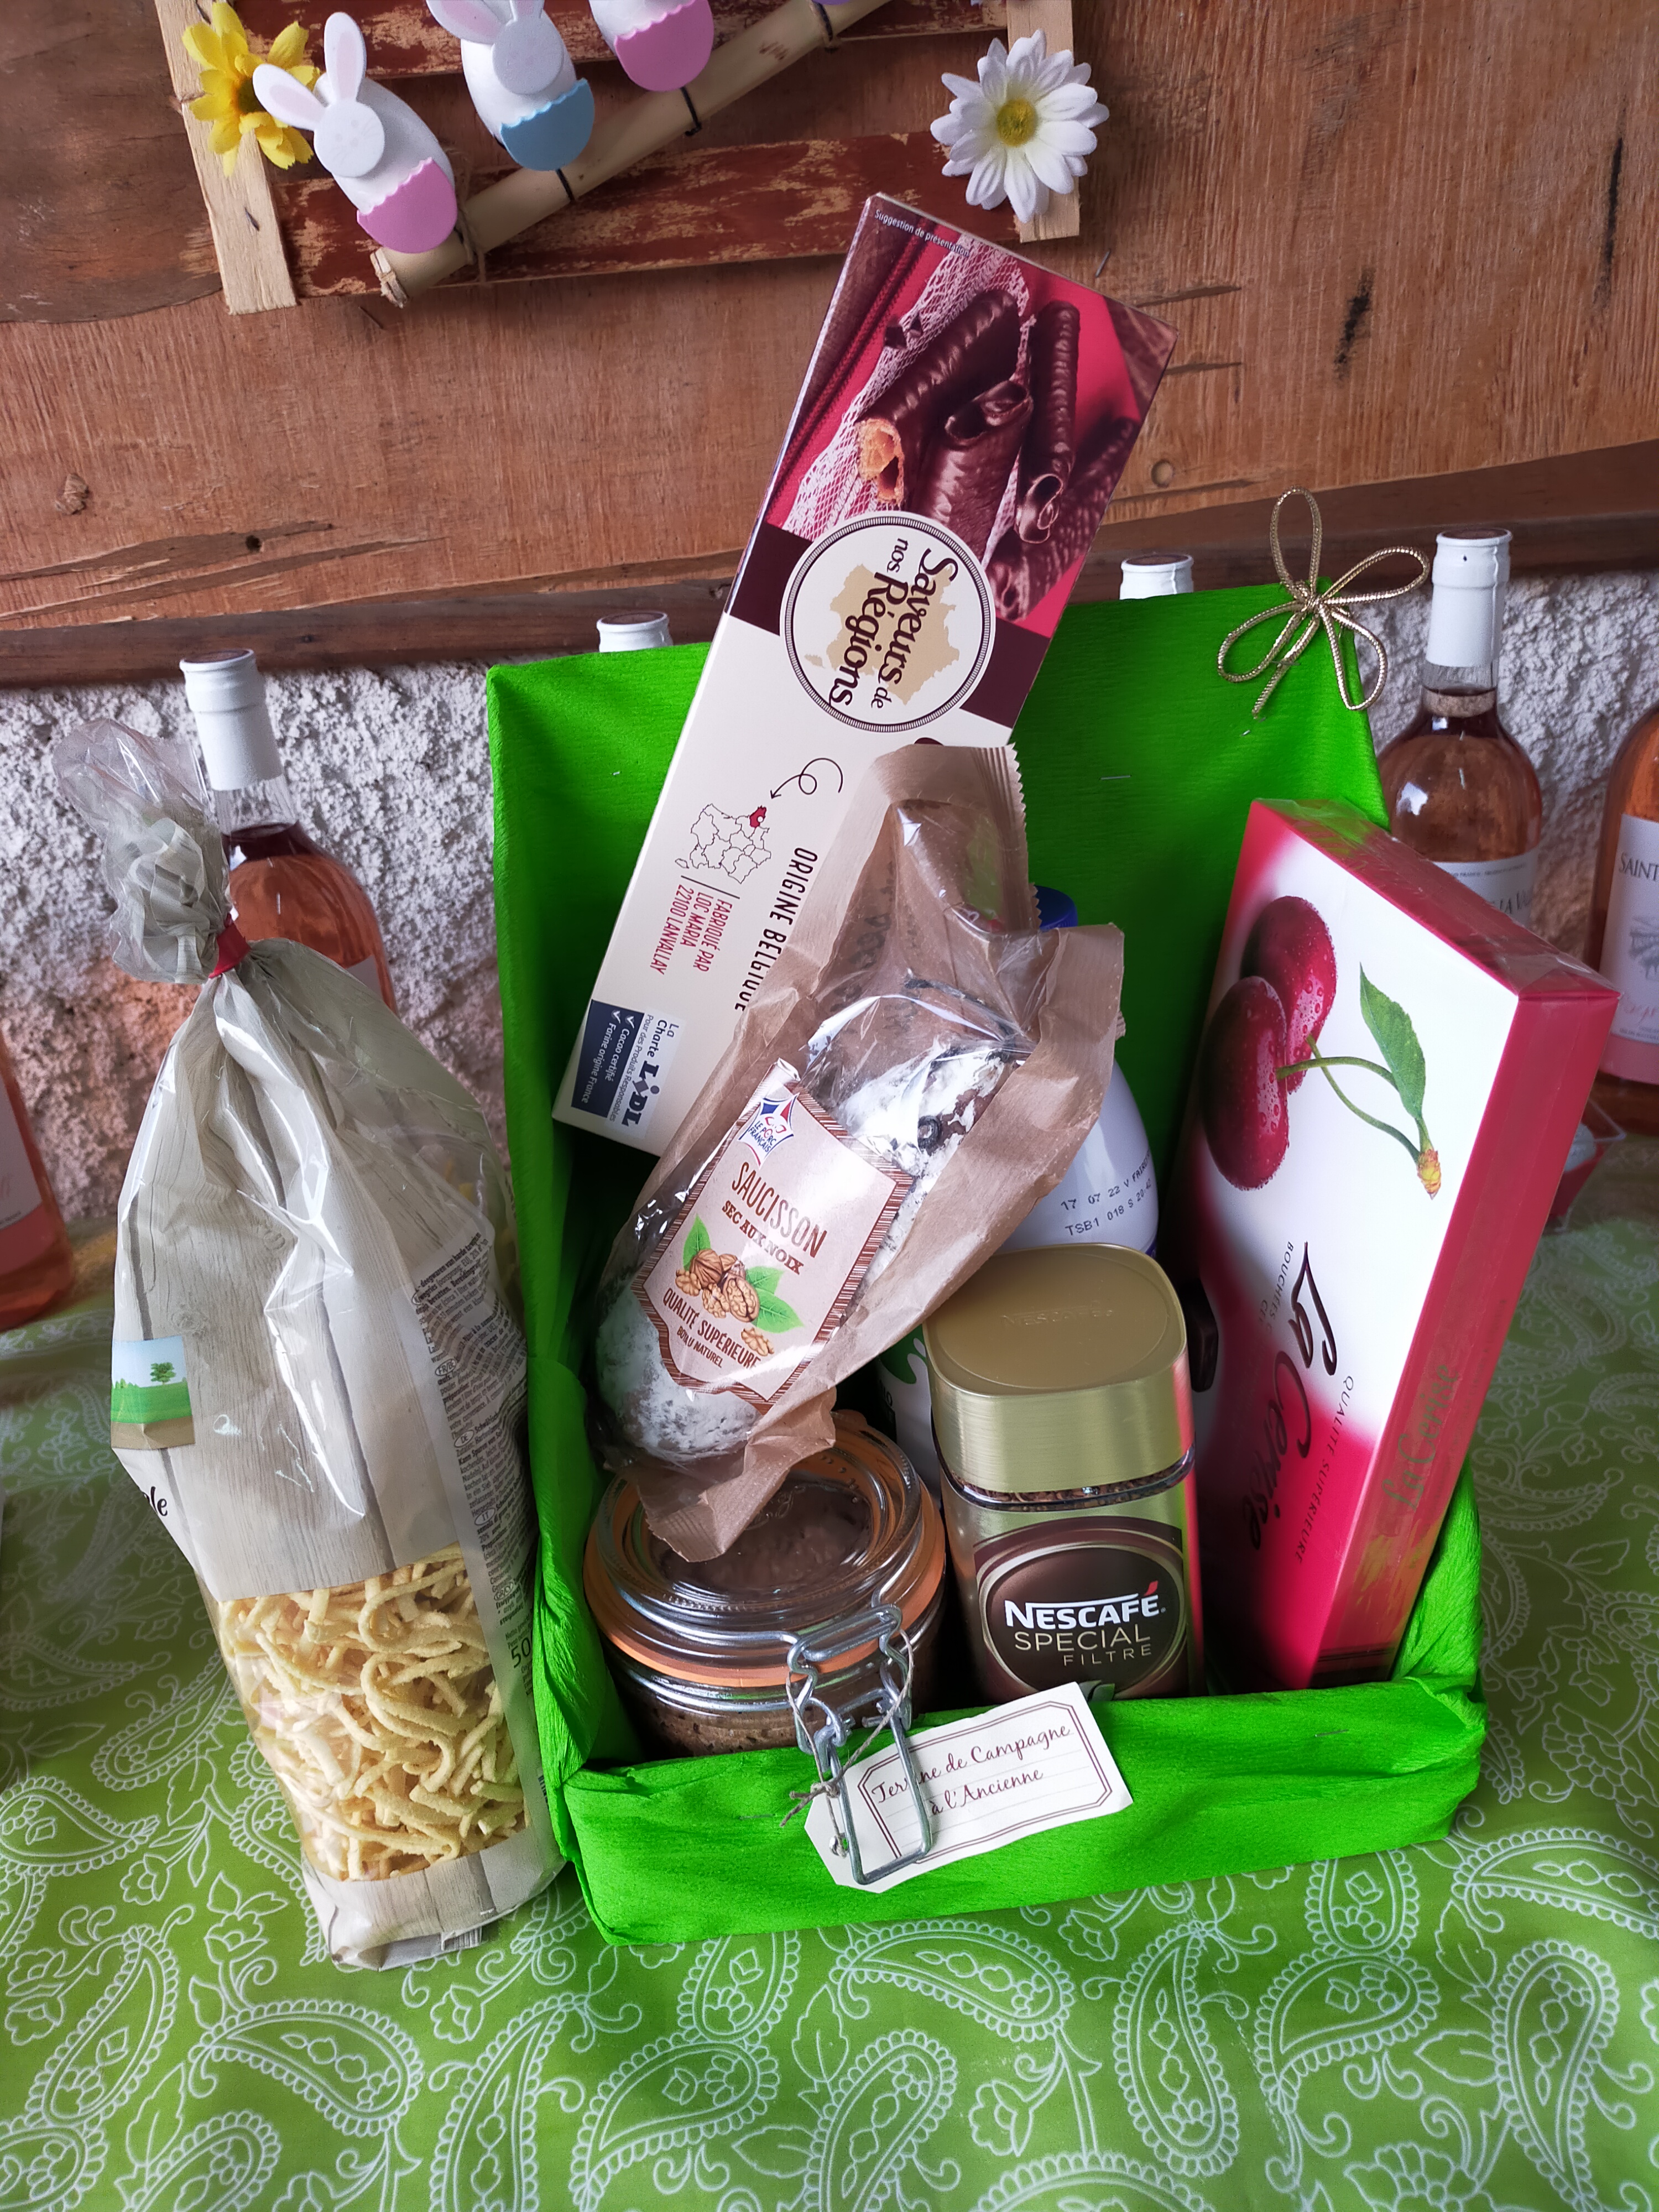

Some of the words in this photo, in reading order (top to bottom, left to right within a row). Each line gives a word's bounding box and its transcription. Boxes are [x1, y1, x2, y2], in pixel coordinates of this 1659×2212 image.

[875, 209, 914, 233] Suggestion
[915, 227, 924, 238] de
[925, 233, 969, 257] présentation
[887, 538, 909, 573] nos
[878, 547, 958, 685] Saveurs
[829, 572, 909, 706] Régions
[871, 687, 892, 708] de
[670, 884, 694, 917] 22100
[693, 892, 713, 913] LOC
[770, 848, 818, 925] ORIGINE
[680, 912, 706, 947] MARIA
[702, 899, 733, 951] FABRIQUÉ
[650, 917, 683, 975] LANVALLAY
[693, 949, 714, 972] PAR
[601, 1022, 616, 1049] Farine
[615, 1028, 629, 1053] Cacao
[638, 1031, 646, 1045] des
[644, 1014, 654, 1032] Pour
[647, 1020, 667, 1057] Charte
[667, 1023, 679, 1037] La
[591, 1050, 605, 1077] origine
[605, 1055, 619, 1082] certifié
[627, 1045, 642, 1074] Produits
[582, 1077, 597, 1103] France
[609, 1074, 632, 1122] Responsables
[748, 1126, 771, 1152] FRANÇAIS
[754, 1120, 763, 1130] LE
[761, 1127, 776, 1145] PORC
[732, 1162, 828, 1258] SAUCISSON
[1061, 1199, 1077, 1211] 17
[1088, 1193, 1100, 1204] 07
[1108, 1186, 1120, 1197] 22
[1124, 1179, 1129, 1187] V
[1065, 1217, 1099, 1235] TSB1
[1107, 1206, 1124, 1220] 018
[1128, 1199, 1134, 1208] S
[722, 1200, 744, 1224] SEC
[740, 1221, 767, 1247] AUX
[765, 1241, 804, 1275] NOIX
[663, 1288, 700, 1328] QUALITÉ
[1288, 1241, 1337, 1376] La
[677, 1326, 693, 1347] BOYAU
[693, 1341, 723, 1368] NATUREL
[1398, 1364, 1458, 1464] Cerise
[1243, 1351, 1311, 1550] Cerise
[1383, 1469, 1425, 1512] La
[1004, 1580, 1159, 1630] NESCAFÉ
[1014, 1624, 1151, 1652] SPECIAL
[1063, 1644, 1152, 1666] FILTRE
[946, 1752, 968, 1773] de
[971, 1724, 1071, 1762] Campagne
[931, 1800, 943, 1816] à
[944, 1770, 1044, 1810] l'Ancienne
